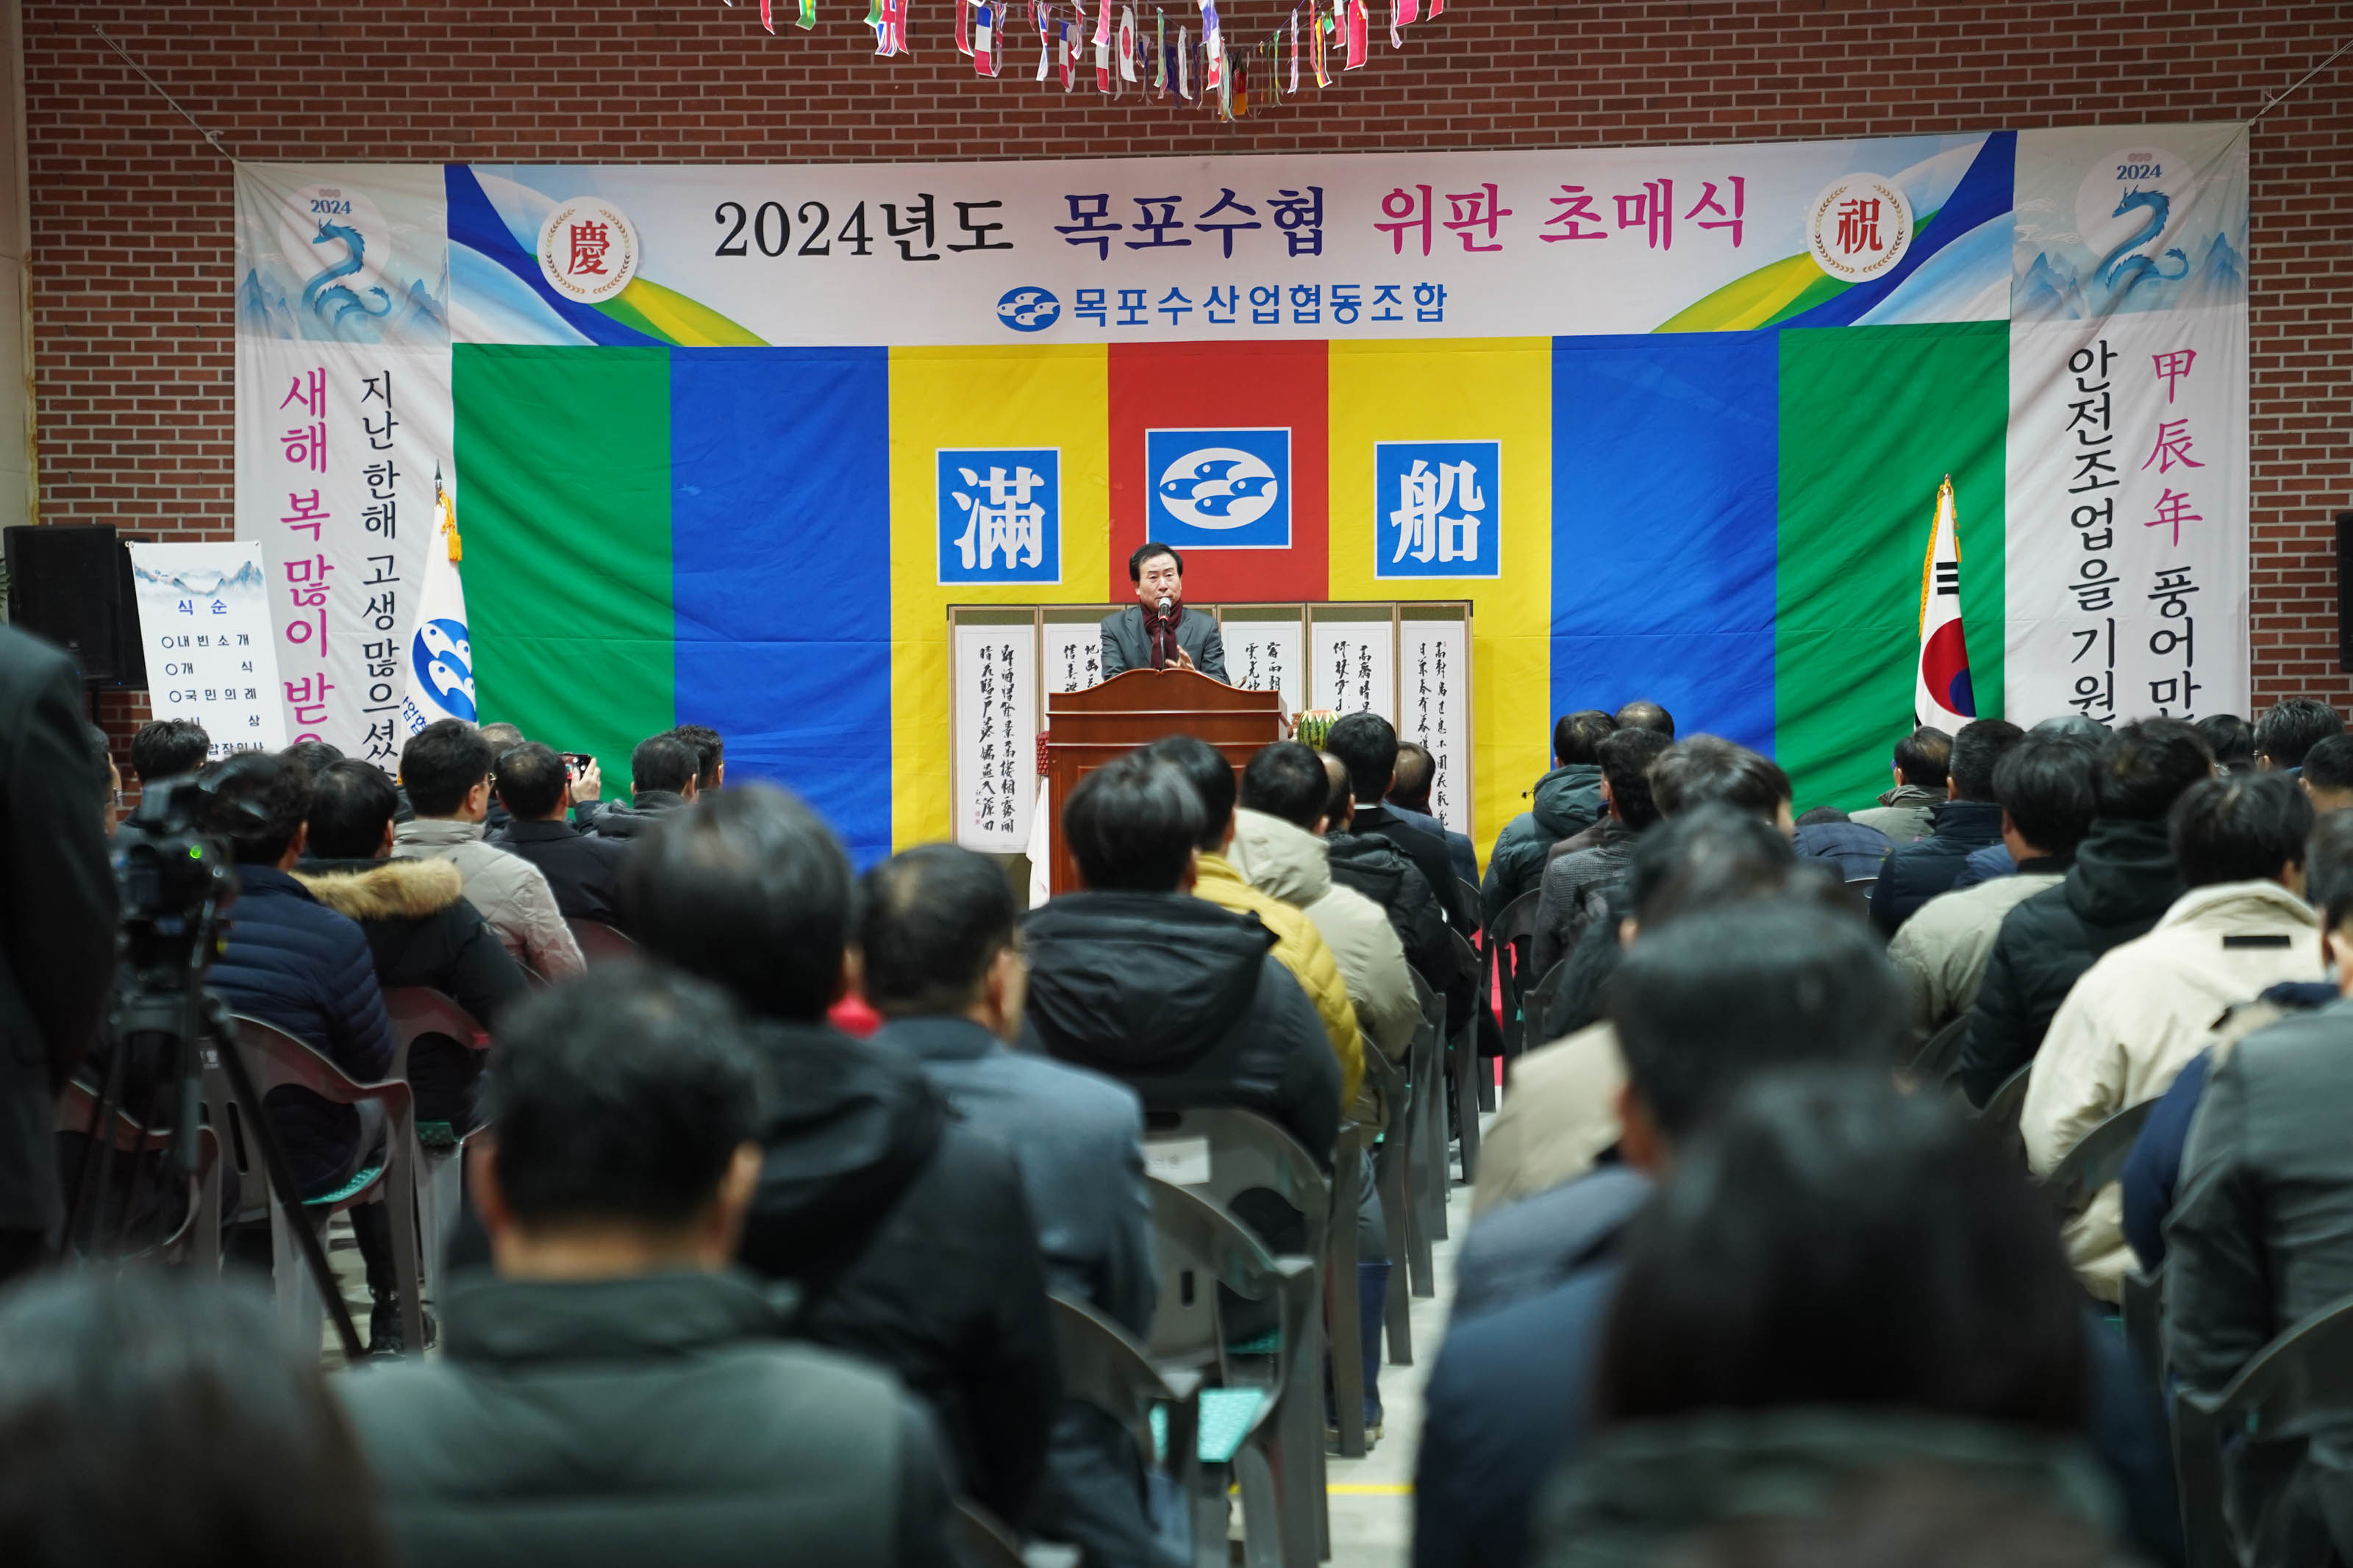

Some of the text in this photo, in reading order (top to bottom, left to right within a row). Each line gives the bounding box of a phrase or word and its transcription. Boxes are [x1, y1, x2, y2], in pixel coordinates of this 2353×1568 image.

[2116, 164, 2163, 180] 2024
[310, 199, 352, 215] 2024
[715, 176, 1746, 262] 2024년도 목포수협 위판 초매식
[1837, 197, 1883, 255] 祝
[567, 220, 610, 276] 慶
[1074, 282, 1448, 327] 목포수산업협동조합
[279, 367, 327, 473] 새해
[361, 370, 399, 450] 지난
[280, 489, 331, 542] 복
[951, 466, 1046, 570] 滿
[1390, 460, 1485, 564] 船
[283, 554, 335, 659] 많이
